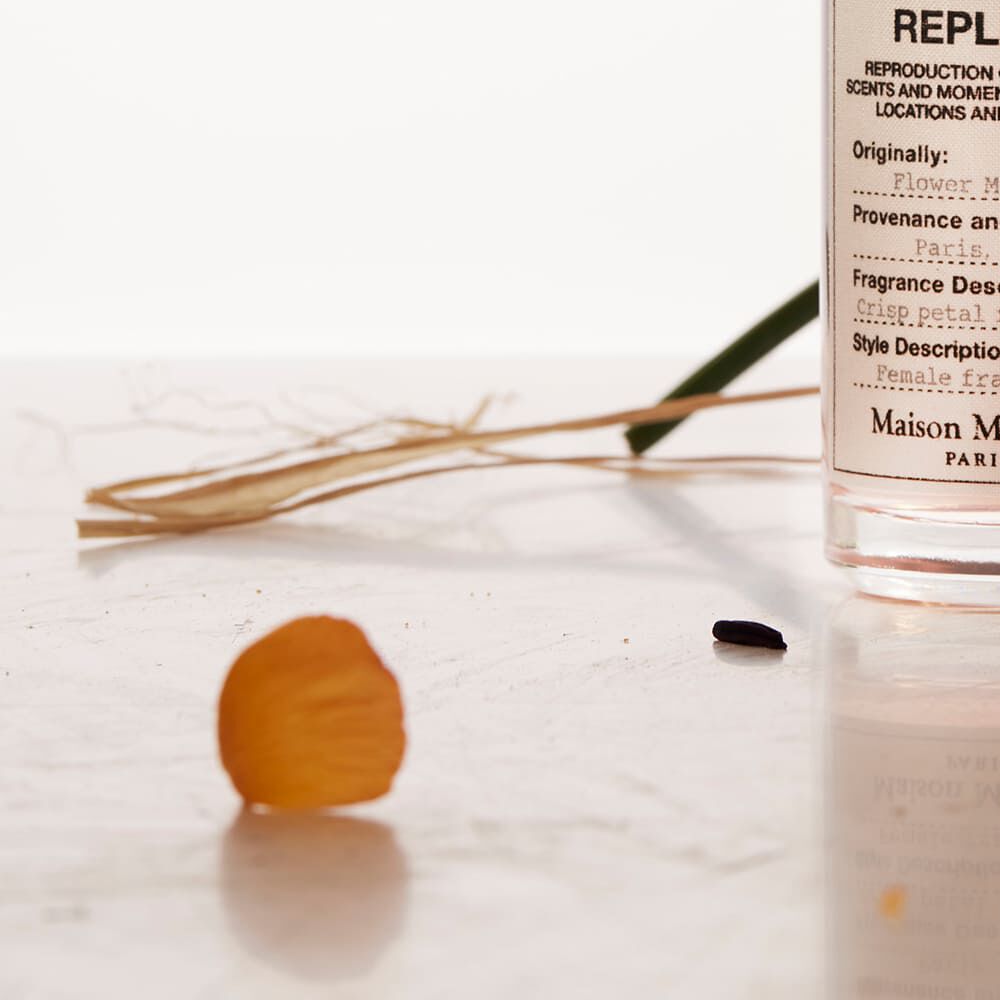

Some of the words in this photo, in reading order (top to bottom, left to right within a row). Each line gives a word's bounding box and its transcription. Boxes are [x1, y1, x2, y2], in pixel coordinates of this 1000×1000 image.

[865, 60, 993, 80] REPRODUCTION
[846, 79, 894, 97] SCENTS
[899, 83, 932, 99] AND
[876, 102, 966, 121] LOCATIONS
[853, 140, 948, 168] Originally:
[893, 172, 972, 193] Flower
[853, 205, 962, 229] Provenance
[853, 269, 944, 295] Fragrance
[857, 298, 909, 324] Crisp
[918, 304, 985, 327] petal
[853, 333, 889, 356] Style
[876, 364, 951, 386] Female
[871, 407, 962, 440] Maison
